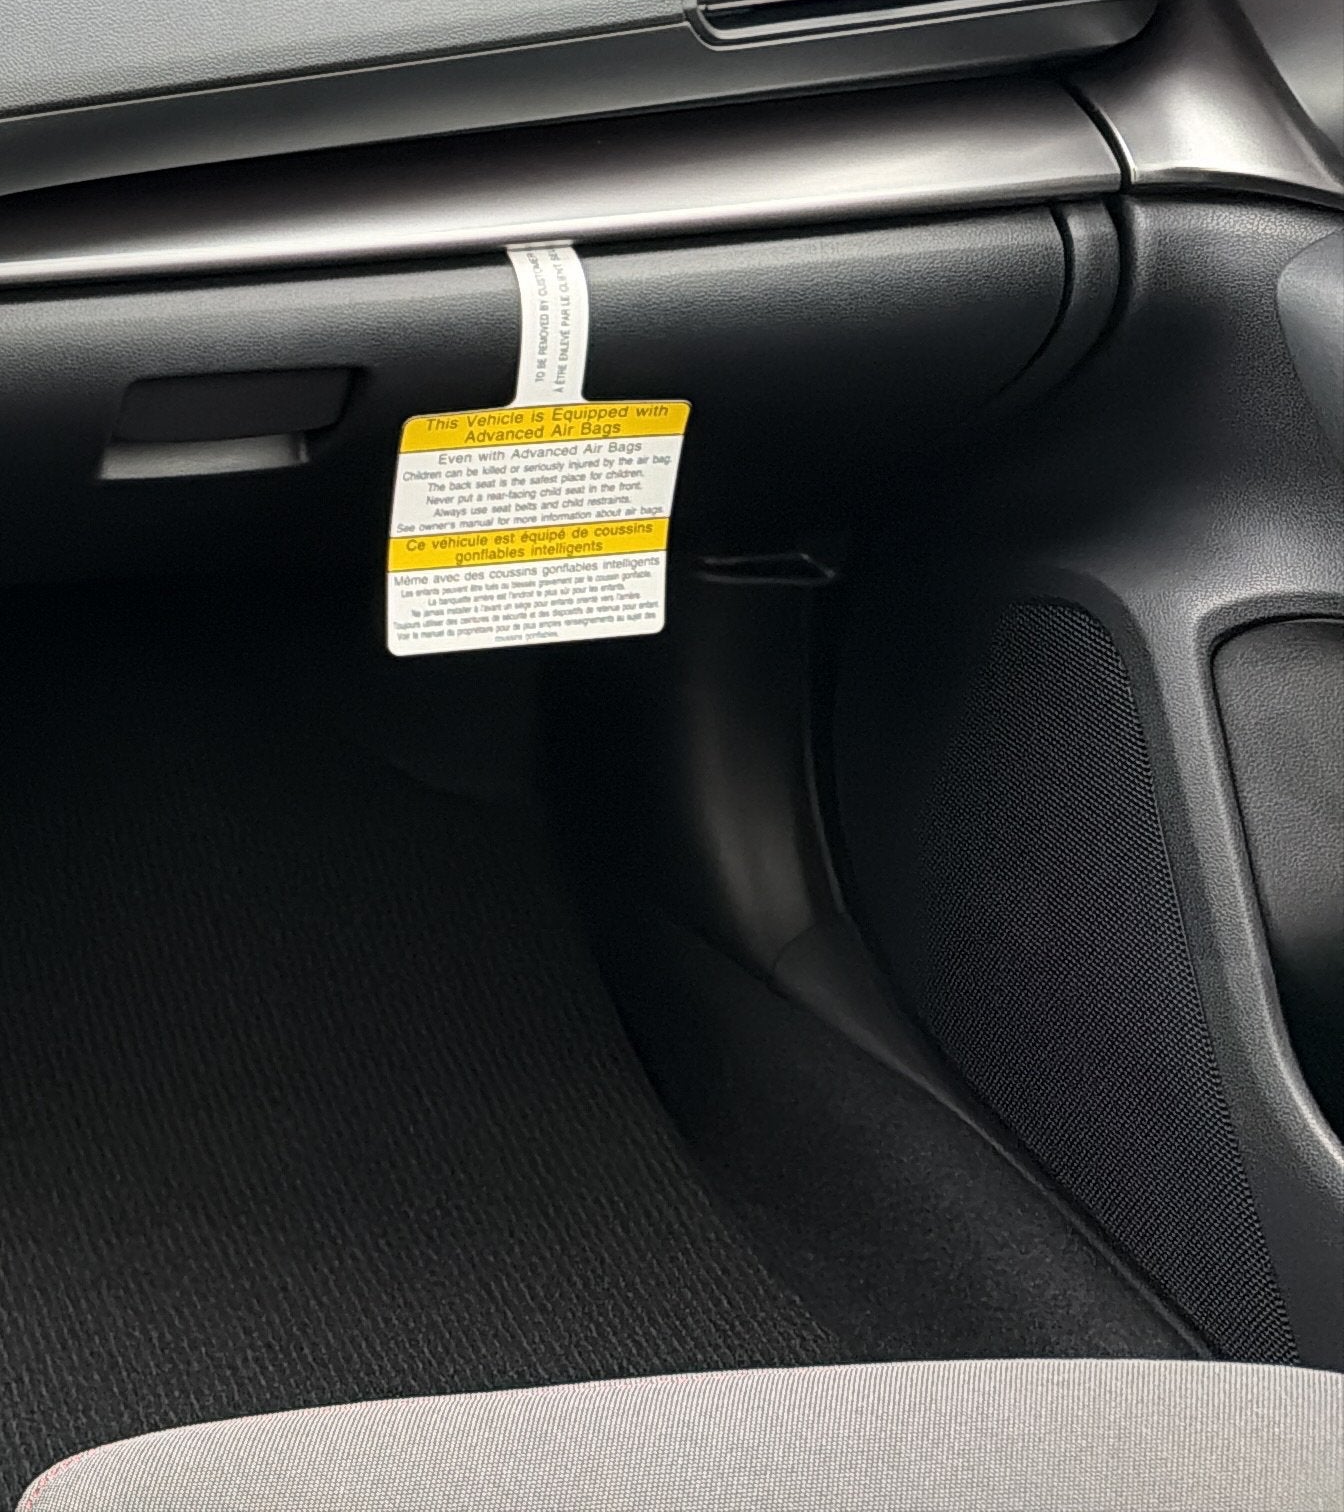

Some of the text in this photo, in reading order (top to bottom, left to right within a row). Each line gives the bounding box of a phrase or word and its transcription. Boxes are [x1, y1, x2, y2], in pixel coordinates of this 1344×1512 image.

[425, 405, 669, 432] This Vehicle is Equipped with
[464, 422, 621, 444] Advanced Air Bags
[438, 441, 642, 465] Even with Advanced Air Bags
[402, 469, 442, 481] Children
[445, 469, 462, 478] can
[466, 467, 479, 477] be
[482, 465, 506, 476] killed
[510, 465, 520, 473] or
[523, 462, 564, 472] seriously
[568, 459, 600, 470] injured
[603, 458, 615, 468] by
[618, 456, 633, 466] the
[636, 456, 650, 465] air
[426, 495, 454, 505] Never
[457, 494, 473, 505] put
[539, 487, 561, 497] child
[565, 486, 585, 496] seat
[588, 484, 597, 493] in
[600, 483, 616, 492] the
[428, 482, 446, 492] The
[449, 480, 471, 491] back
[476, 479, 496, 489] seat
[499, 478, 507, 487] is
[511, 477, 526, 486] the
[529, 475, 559, 485] safest
[561, 473, 586, 484] place
[590, 471, 602, 481] for
[396, 523, 415, 533] See
[459, 518, 493, 528] manual
[497, 516, 510, 525] for
[513, 515, 537, 524] more
[541, 511, 592, 522] information
[595, 508, 622, 518] about
[433, 508, 466, 518] Always
[470, 506, 488, 515] use
[492, 504, 511, 513] seat
[515, 502, 538, 512] belts
[541, 500, 559, 510] and
[562, 498, 584, 508] child
[406, 538, 426, 551] Ce
[494, 533, 515, 544] est
[520, 529, 566, 544] équipé
[572, 527, 589, 539] de
[594, 522, 653, 537] coussins
[455, 540, 604, 565] gonflables intelligents
[433, 573, 460, 584] avec
[464, 571, 485, 581] des
[488, 567, 538, 579] coussins
[542, 562, 598, 577] gonflables
[602, 557, 660, 570] intelligents
